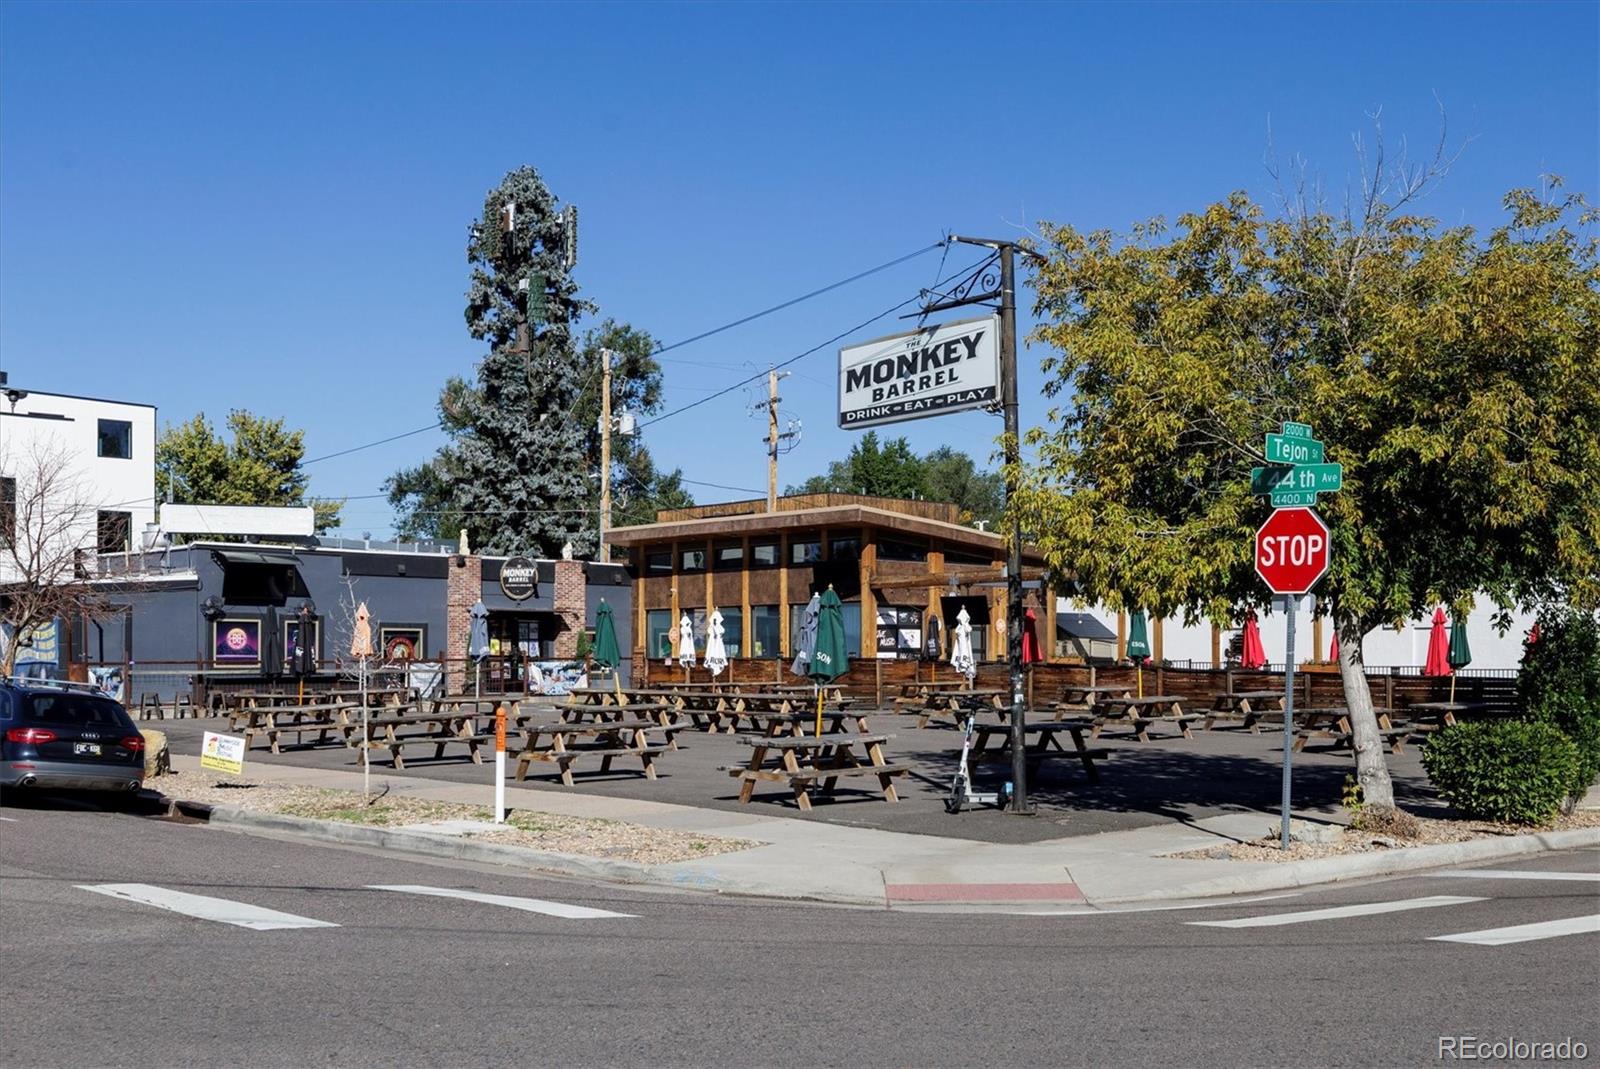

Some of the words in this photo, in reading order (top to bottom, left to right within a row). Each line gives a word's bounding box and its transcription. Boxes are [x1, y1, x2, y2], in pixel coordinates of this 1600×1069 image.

[906, 340, 920, 349] THE
[845, 331, 985, 393] MONKEY
[872, 367, 959, 402] BARREL
[846, 405, 890, 421] DRINK
[904, 398, 933, 411] EAT
[947, 388, 988, 404] PLAY
[1286, 424, 1304, 437] 2000
[1274, 438, 1308, 461] Tejon
[1312, 448, 1319, 459] St
[1267, 469, 1315, 489] 44th
[1321, 473, 1338, 483] Ave
[1274, 494, 1300, 504] 4400
[1306, 493, 1314, 502] N
[1260, 534, 1323, 567] STOP
[503, 568, 535, 577] MONKEY
